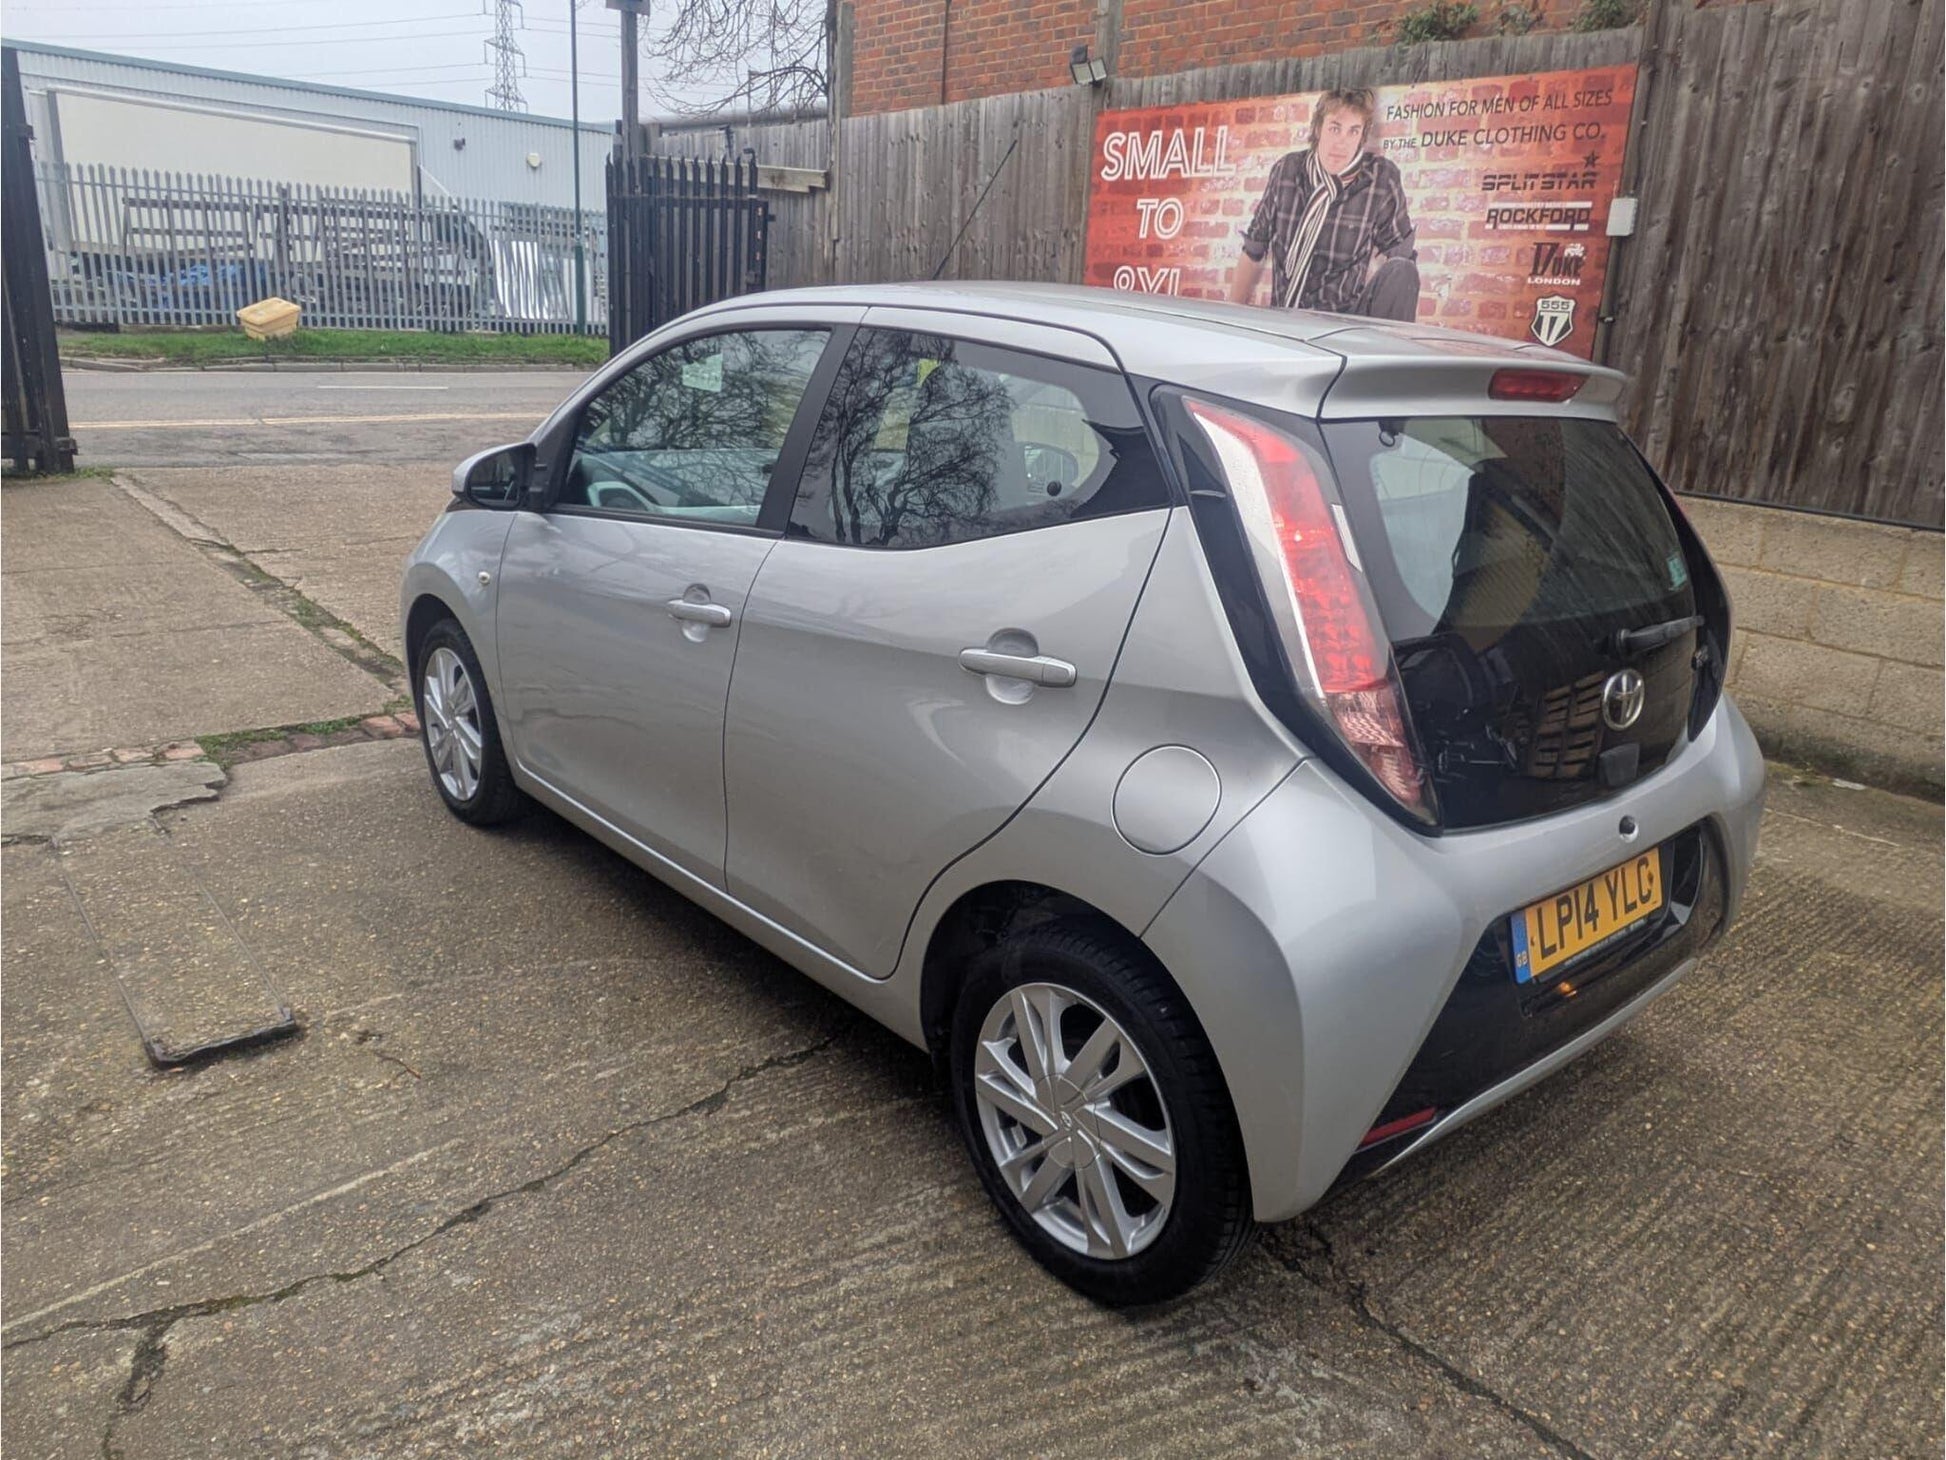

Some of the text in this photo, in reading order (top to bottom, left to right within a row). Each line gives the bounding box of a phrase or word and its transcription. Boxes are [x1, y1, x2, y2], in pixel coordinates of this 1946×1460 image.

[1387, 89, 1612, 120] FASHION FOR MEN OF ALL SIZES
[1383, 122, 1605, 149] BY THE DUKE CLOTHING CO.
[1101, 126, 1236, 181] SMALL
[1136, 197, 1184, 240] TO
[1486, 207, 1591, 229] ROCKFORD
[1527, 277, 1581, 286] LONDON
[1541, 300, 1570, 309] 555
[1537, 883, 1599, 960] LP14
[1605, 857, 1652, 921] YLC
